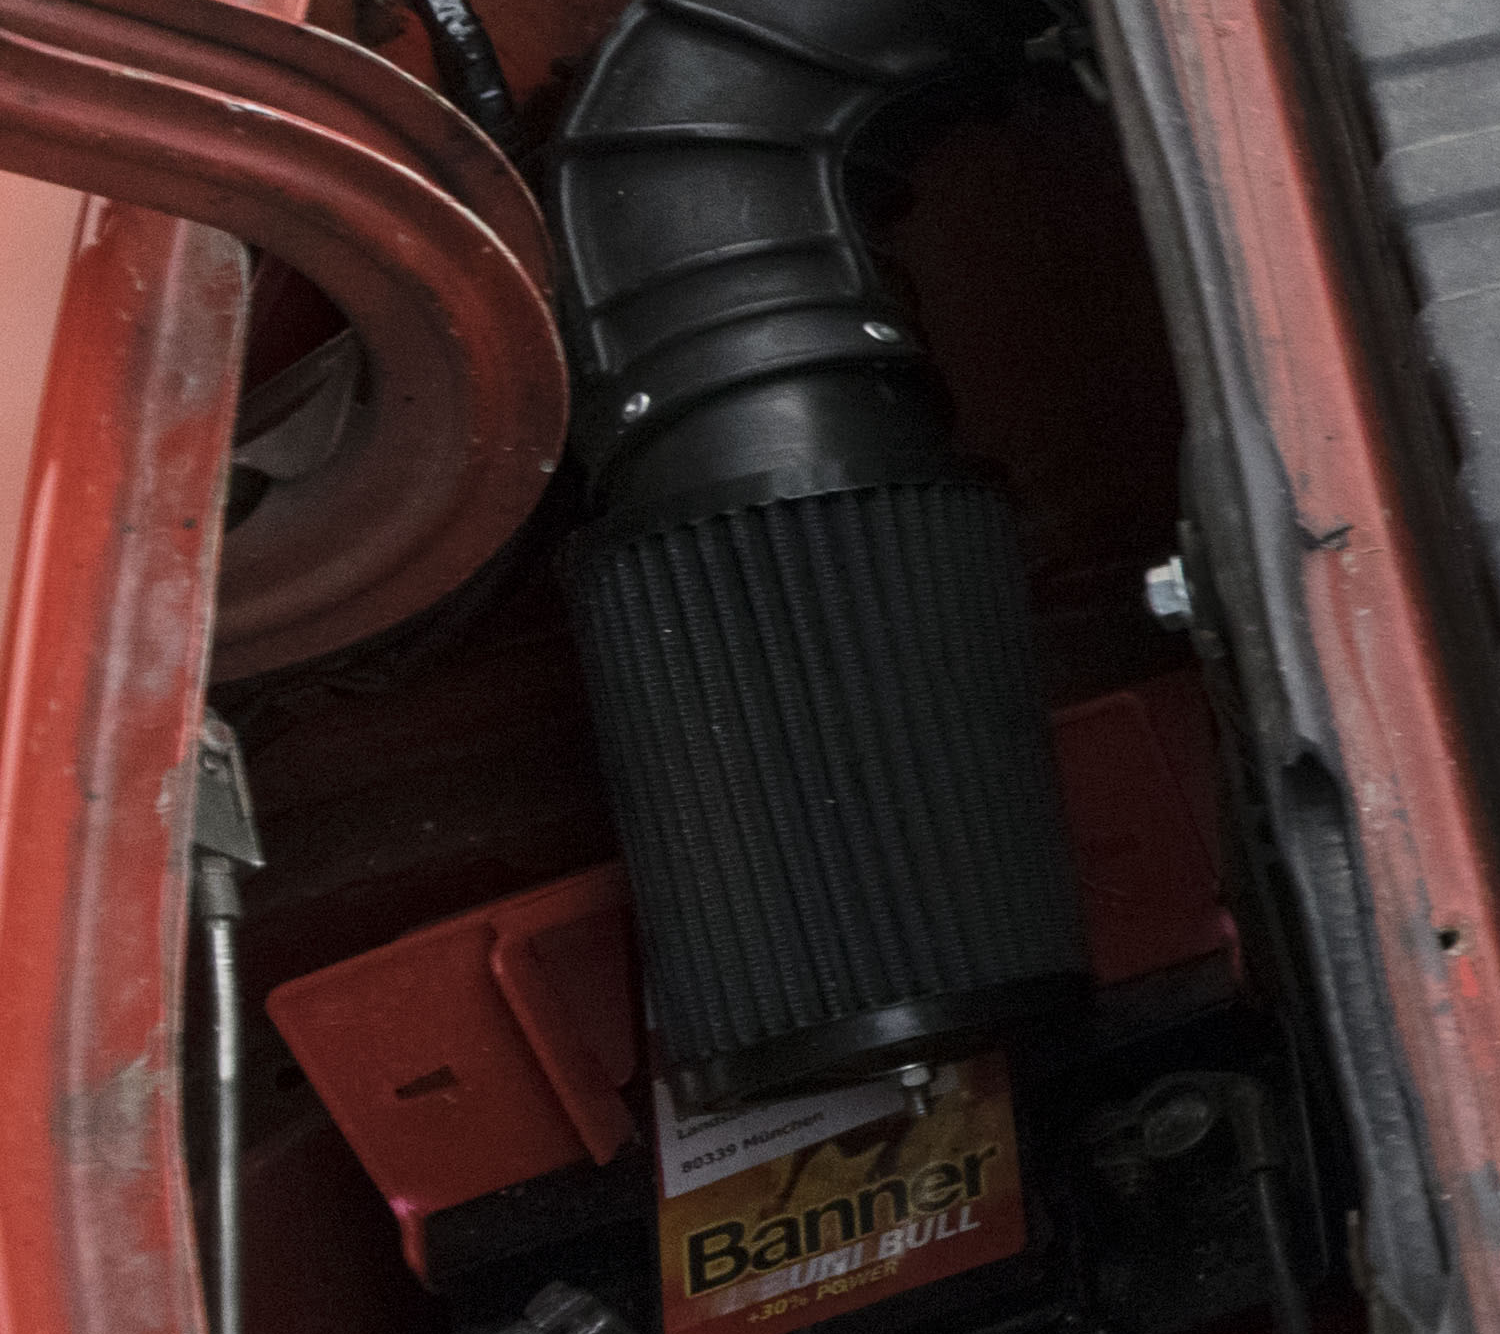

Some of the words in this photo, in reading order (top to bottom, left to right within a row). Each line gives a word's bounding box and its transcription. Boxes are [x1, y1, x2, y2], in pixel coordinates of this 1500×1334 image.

[738, 1110, 829, 1150] München
[688, 1148, 996, 1296] Banner
[788, 1240, 872, 1290] UNI
[872, 1202, 984, 1260] BULL
[809, 1256, 905, 1302] POWER
